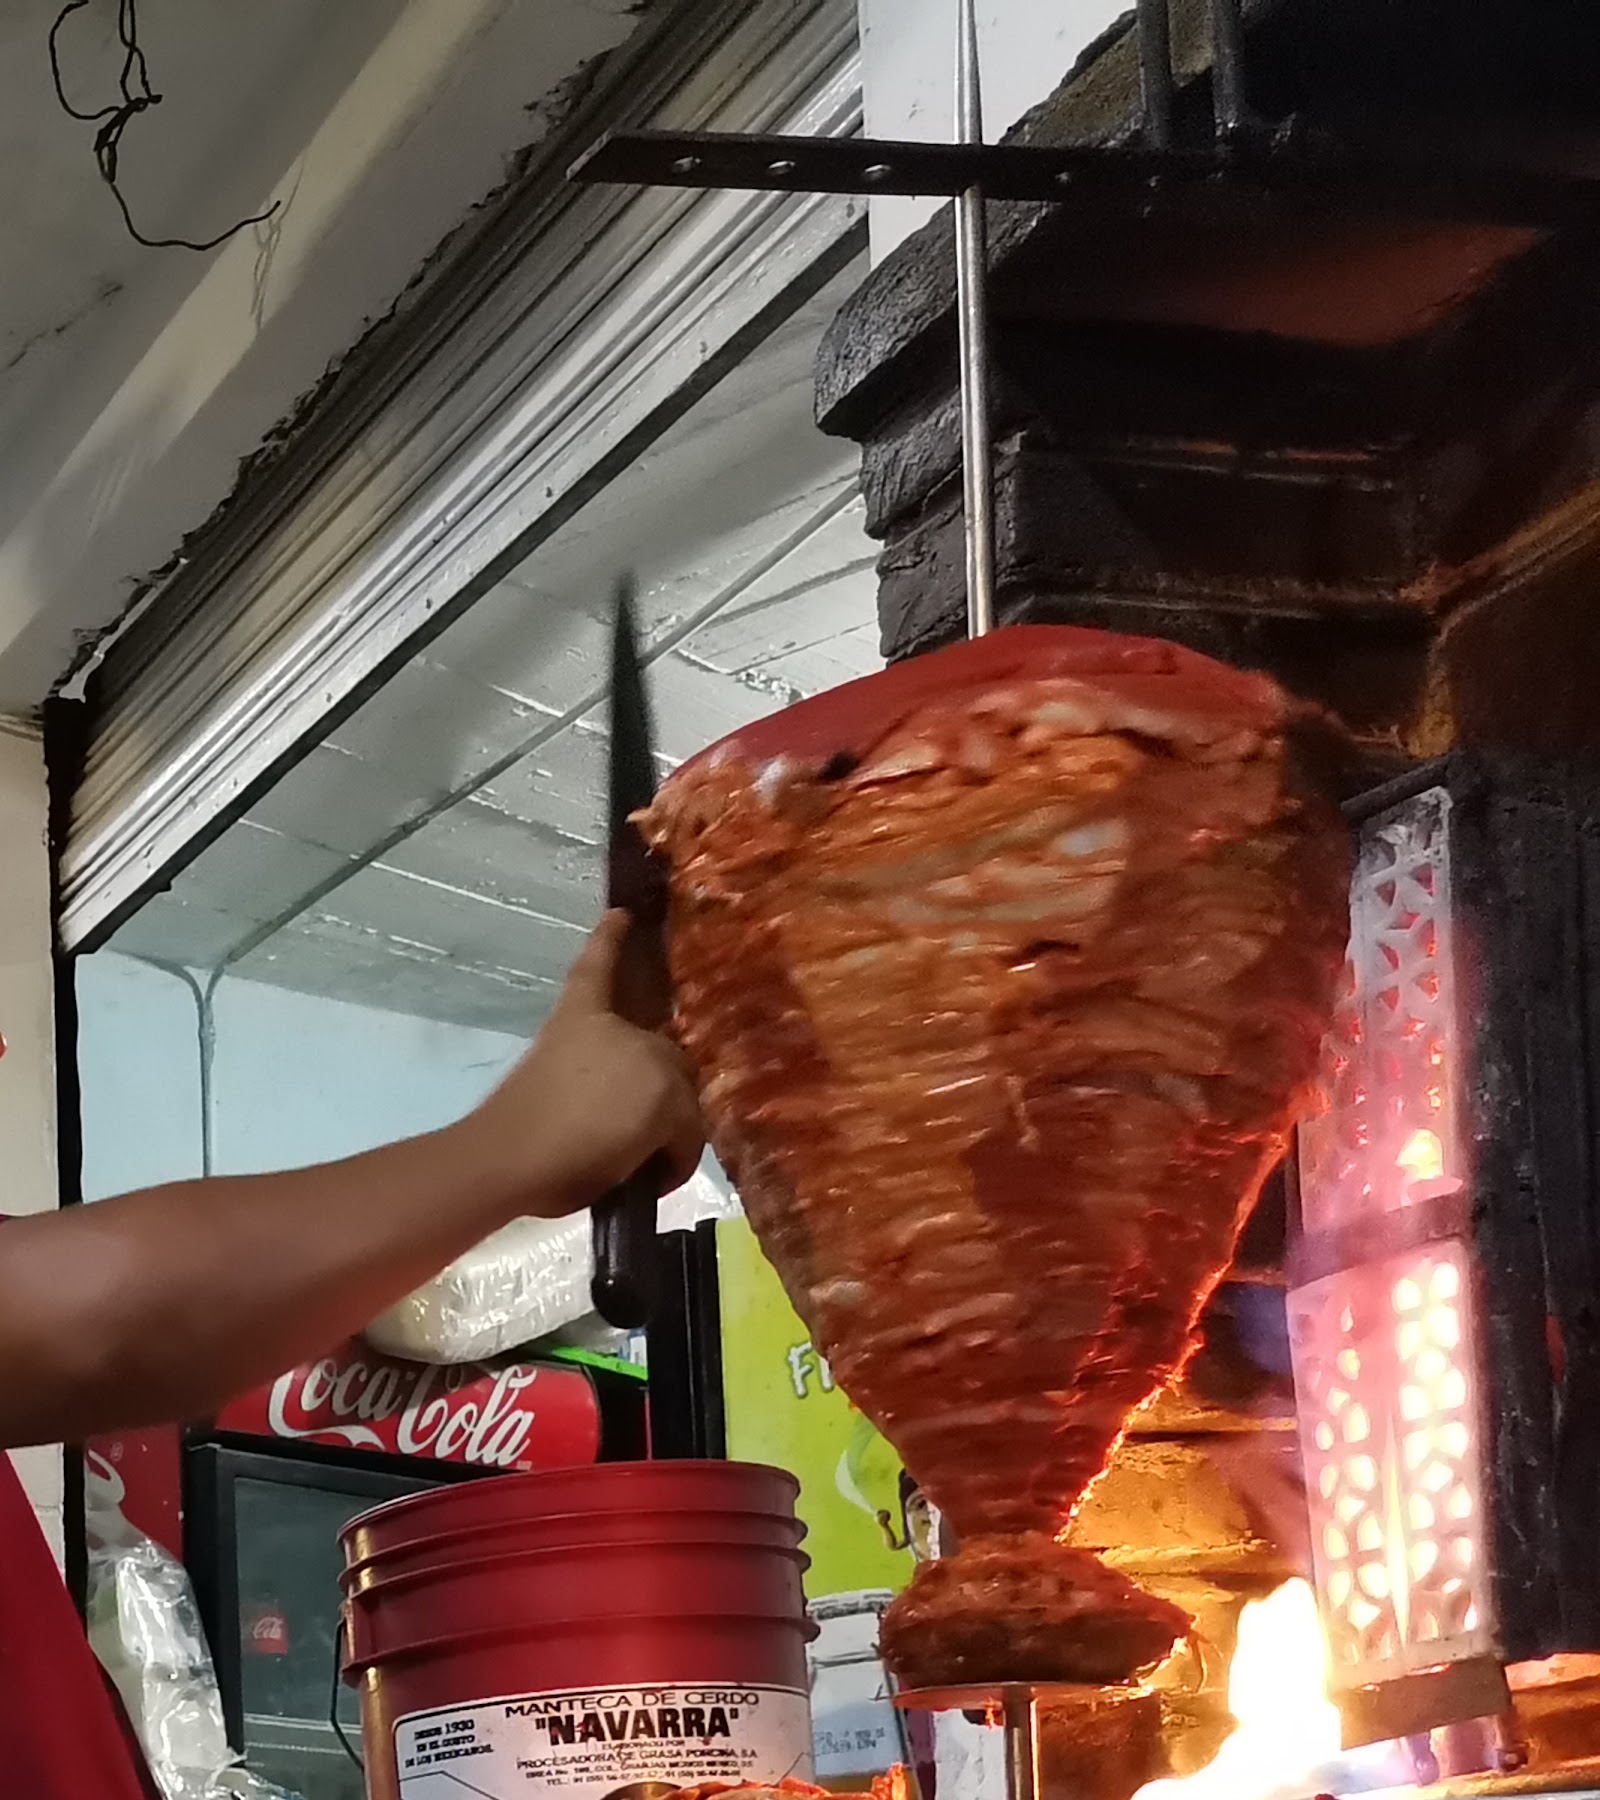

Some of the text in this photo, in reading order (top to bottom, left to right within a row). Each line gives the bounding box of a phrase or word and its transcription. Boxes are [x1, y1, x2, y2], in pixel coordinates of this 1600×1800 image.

[505, 1691, 760, 1718] MANTECA DE CERDO
[535, 1707, 740, 1746] "NAVARRA"
[516, 1752, 617, 1770] PROCESADORA
